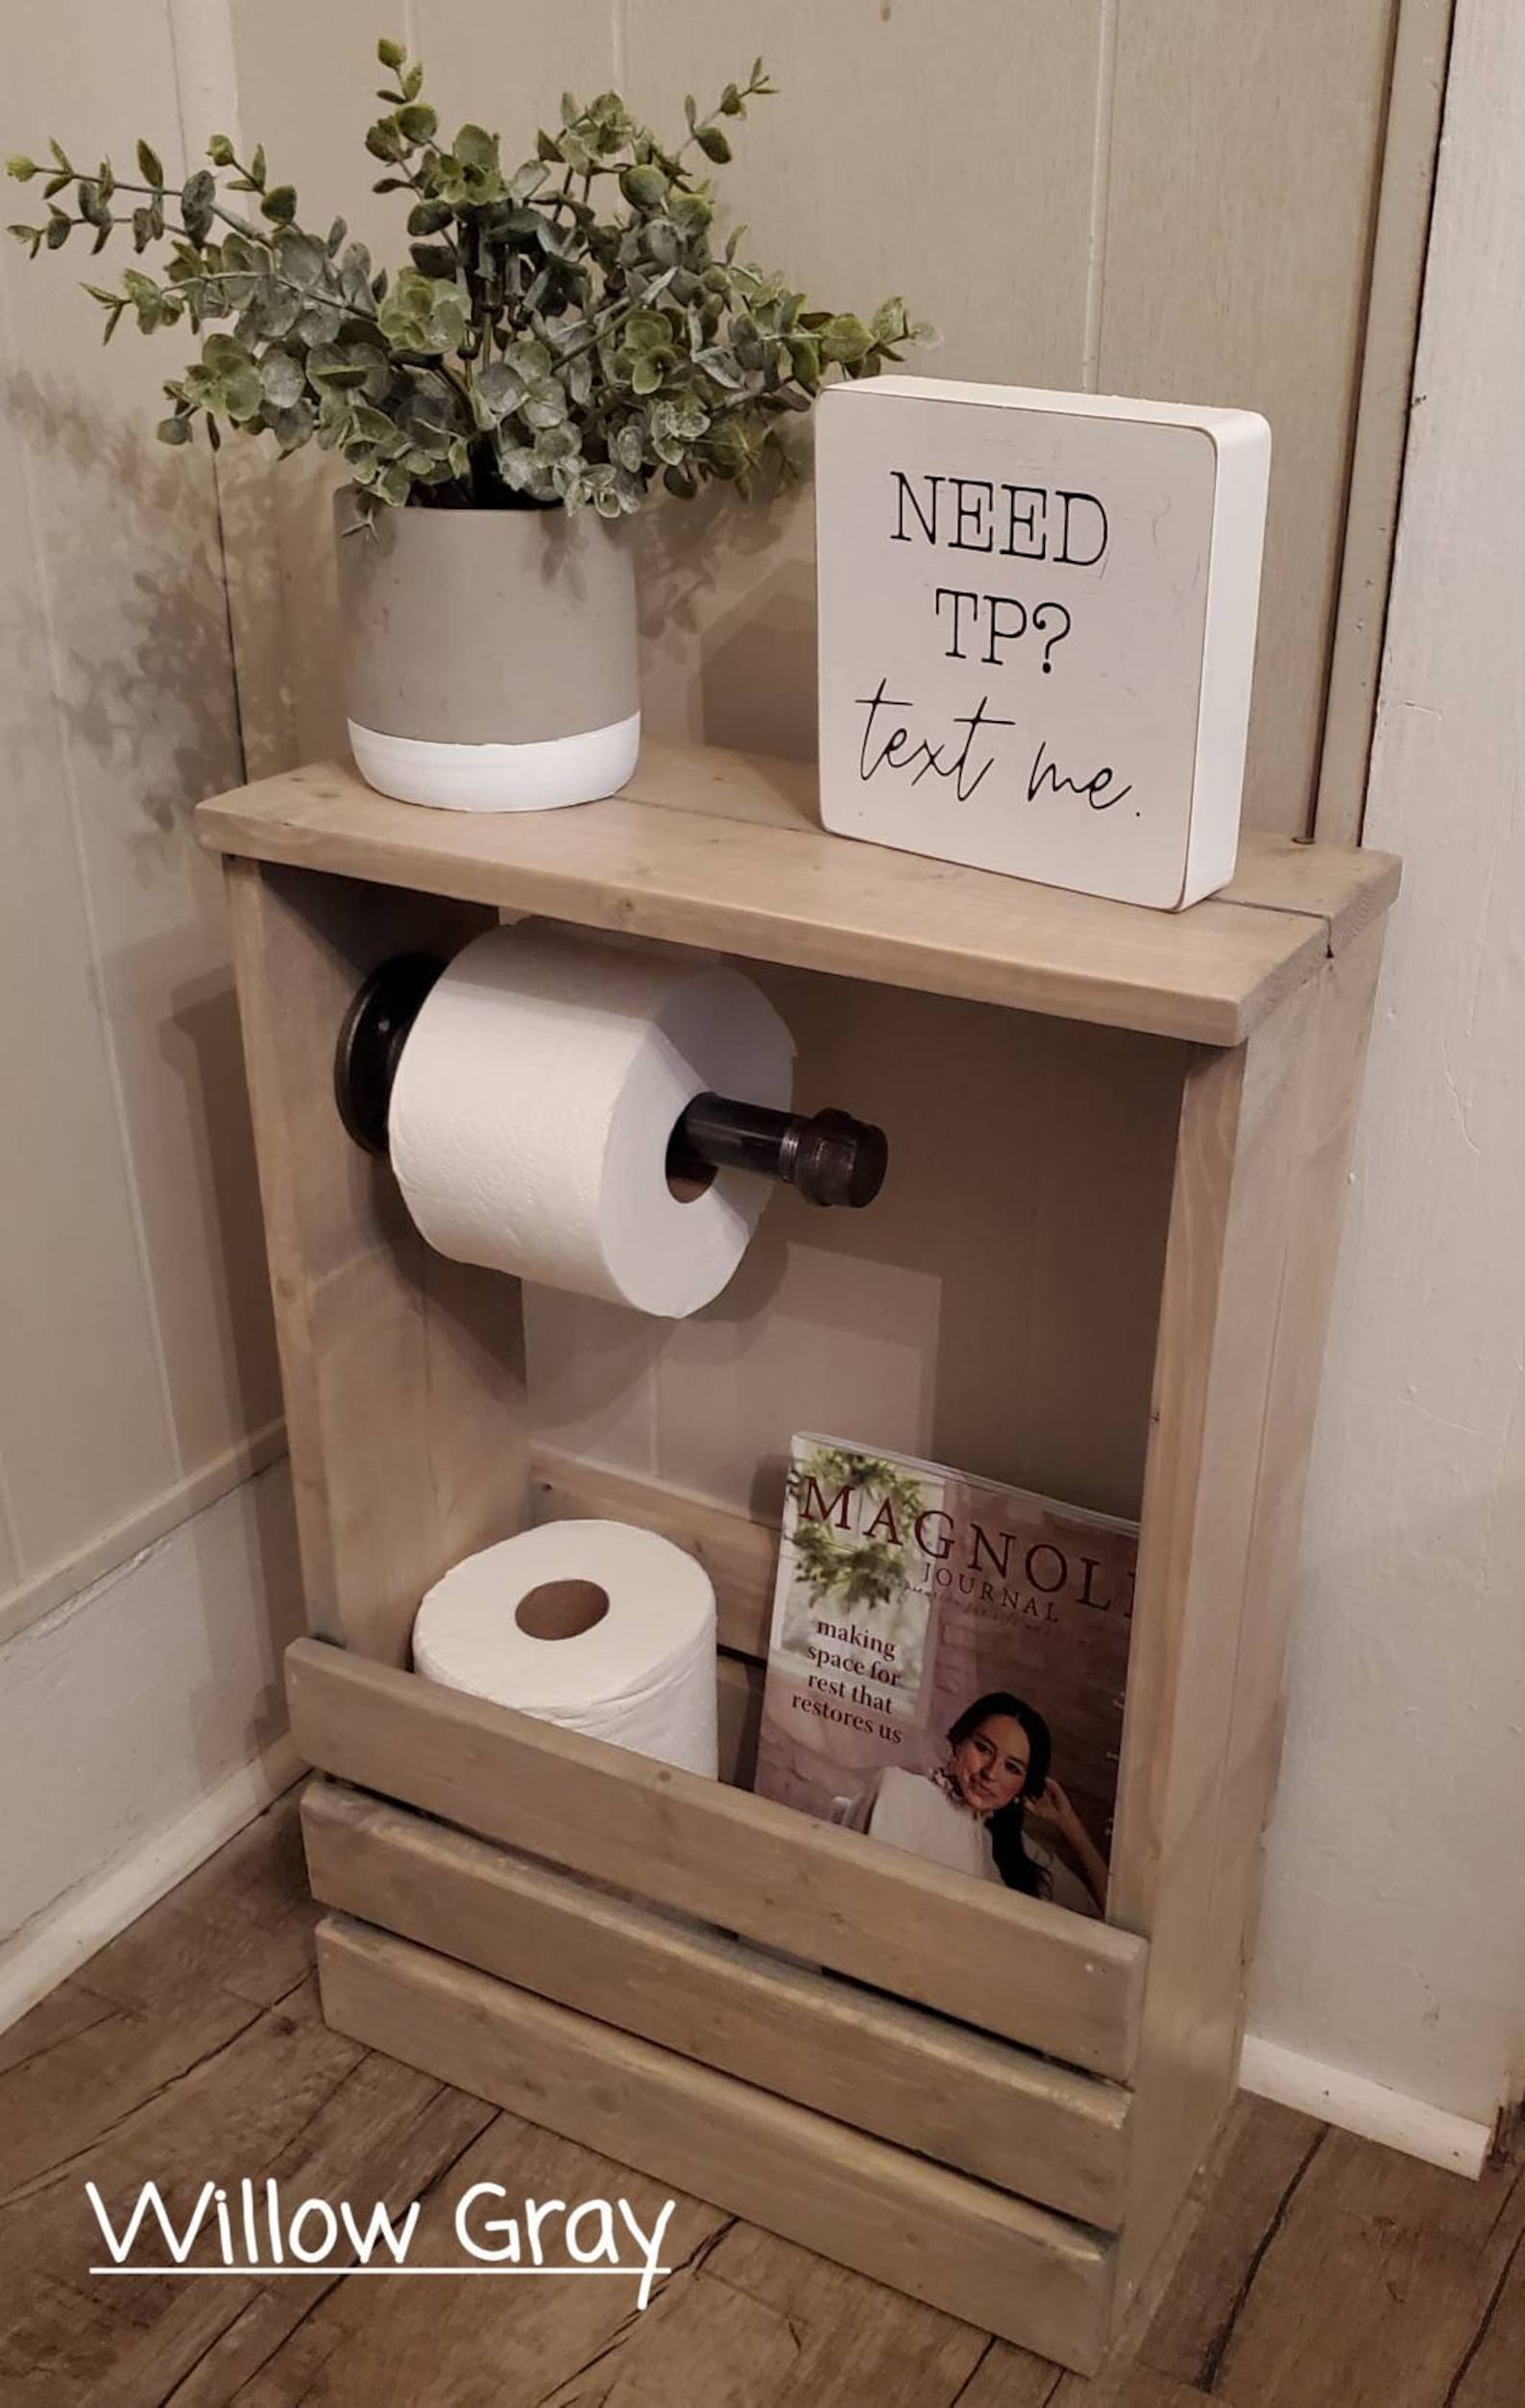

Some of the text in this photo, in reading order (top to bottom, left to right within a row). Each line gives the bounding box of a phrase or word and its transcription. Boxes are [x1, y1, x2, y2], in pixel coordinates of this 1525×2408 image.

[889, 470, 1108, 567] NEED
[934, 588, 1072, 674] TP?
[855, 678, 1142, 817] text me.
[921, 1561, 1060, 1623] JOURNAL
[806, 1643, 901, 1689] space for
[816, 1618, 897, 1663] making
[790, 1691, 903, 1745] restores us
[807, 1671, 893, 1715] rest that
